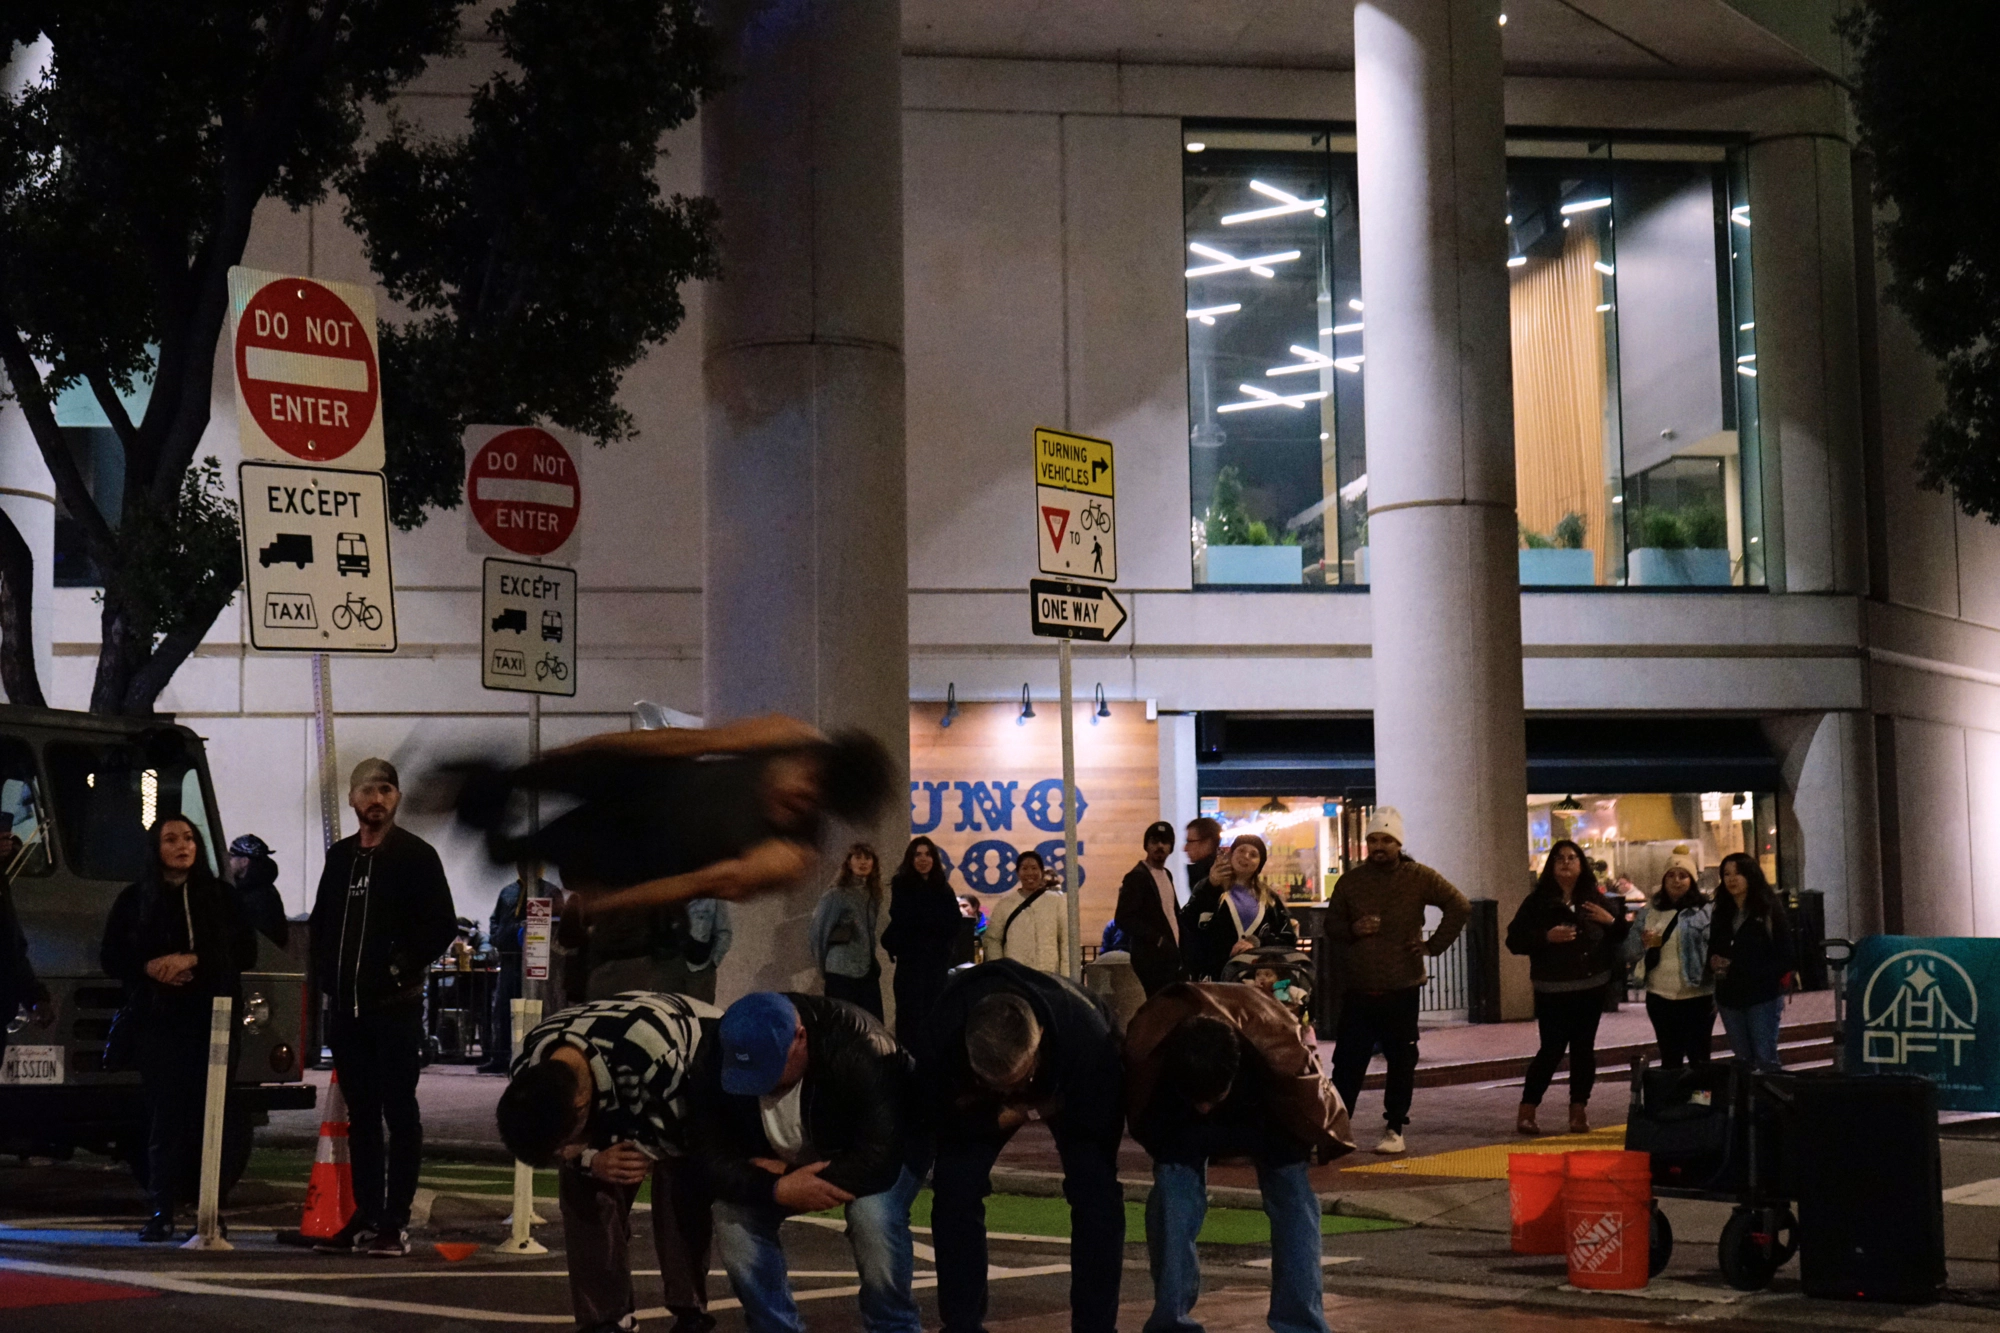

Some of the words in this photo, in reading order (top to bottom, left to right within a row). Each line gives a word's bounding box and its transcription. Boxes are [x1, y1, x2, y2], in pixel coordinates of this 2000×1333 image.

[254, 309, 289, 339] DO
[305, 317, 354, 348] NOT
[270, 393, 350, 428] ENTER
[487, 451, 518, 471] DO
[532, 457, 567, 477] NOT
[1042, 440, 1087, 463] TURNING
[1041, 463, 1089, 486] VEHICLES
[267, 486, 361, 518] EXCEPT
[496, 508, 560, 533] ENTER
[1070, 531, 1080, 545] TO
[500, 575, 562, 601] EXCEPT
[269, 602, 312, 621] TAXI
[1041, 598, 1069, 621] ONE
[1072, 601, 1100, 623] WAY
[495, 655, 523, 672] TAXI
[911, 778, 1088, 834] UNO
[7, 1060, 57, 1078] MISSION
